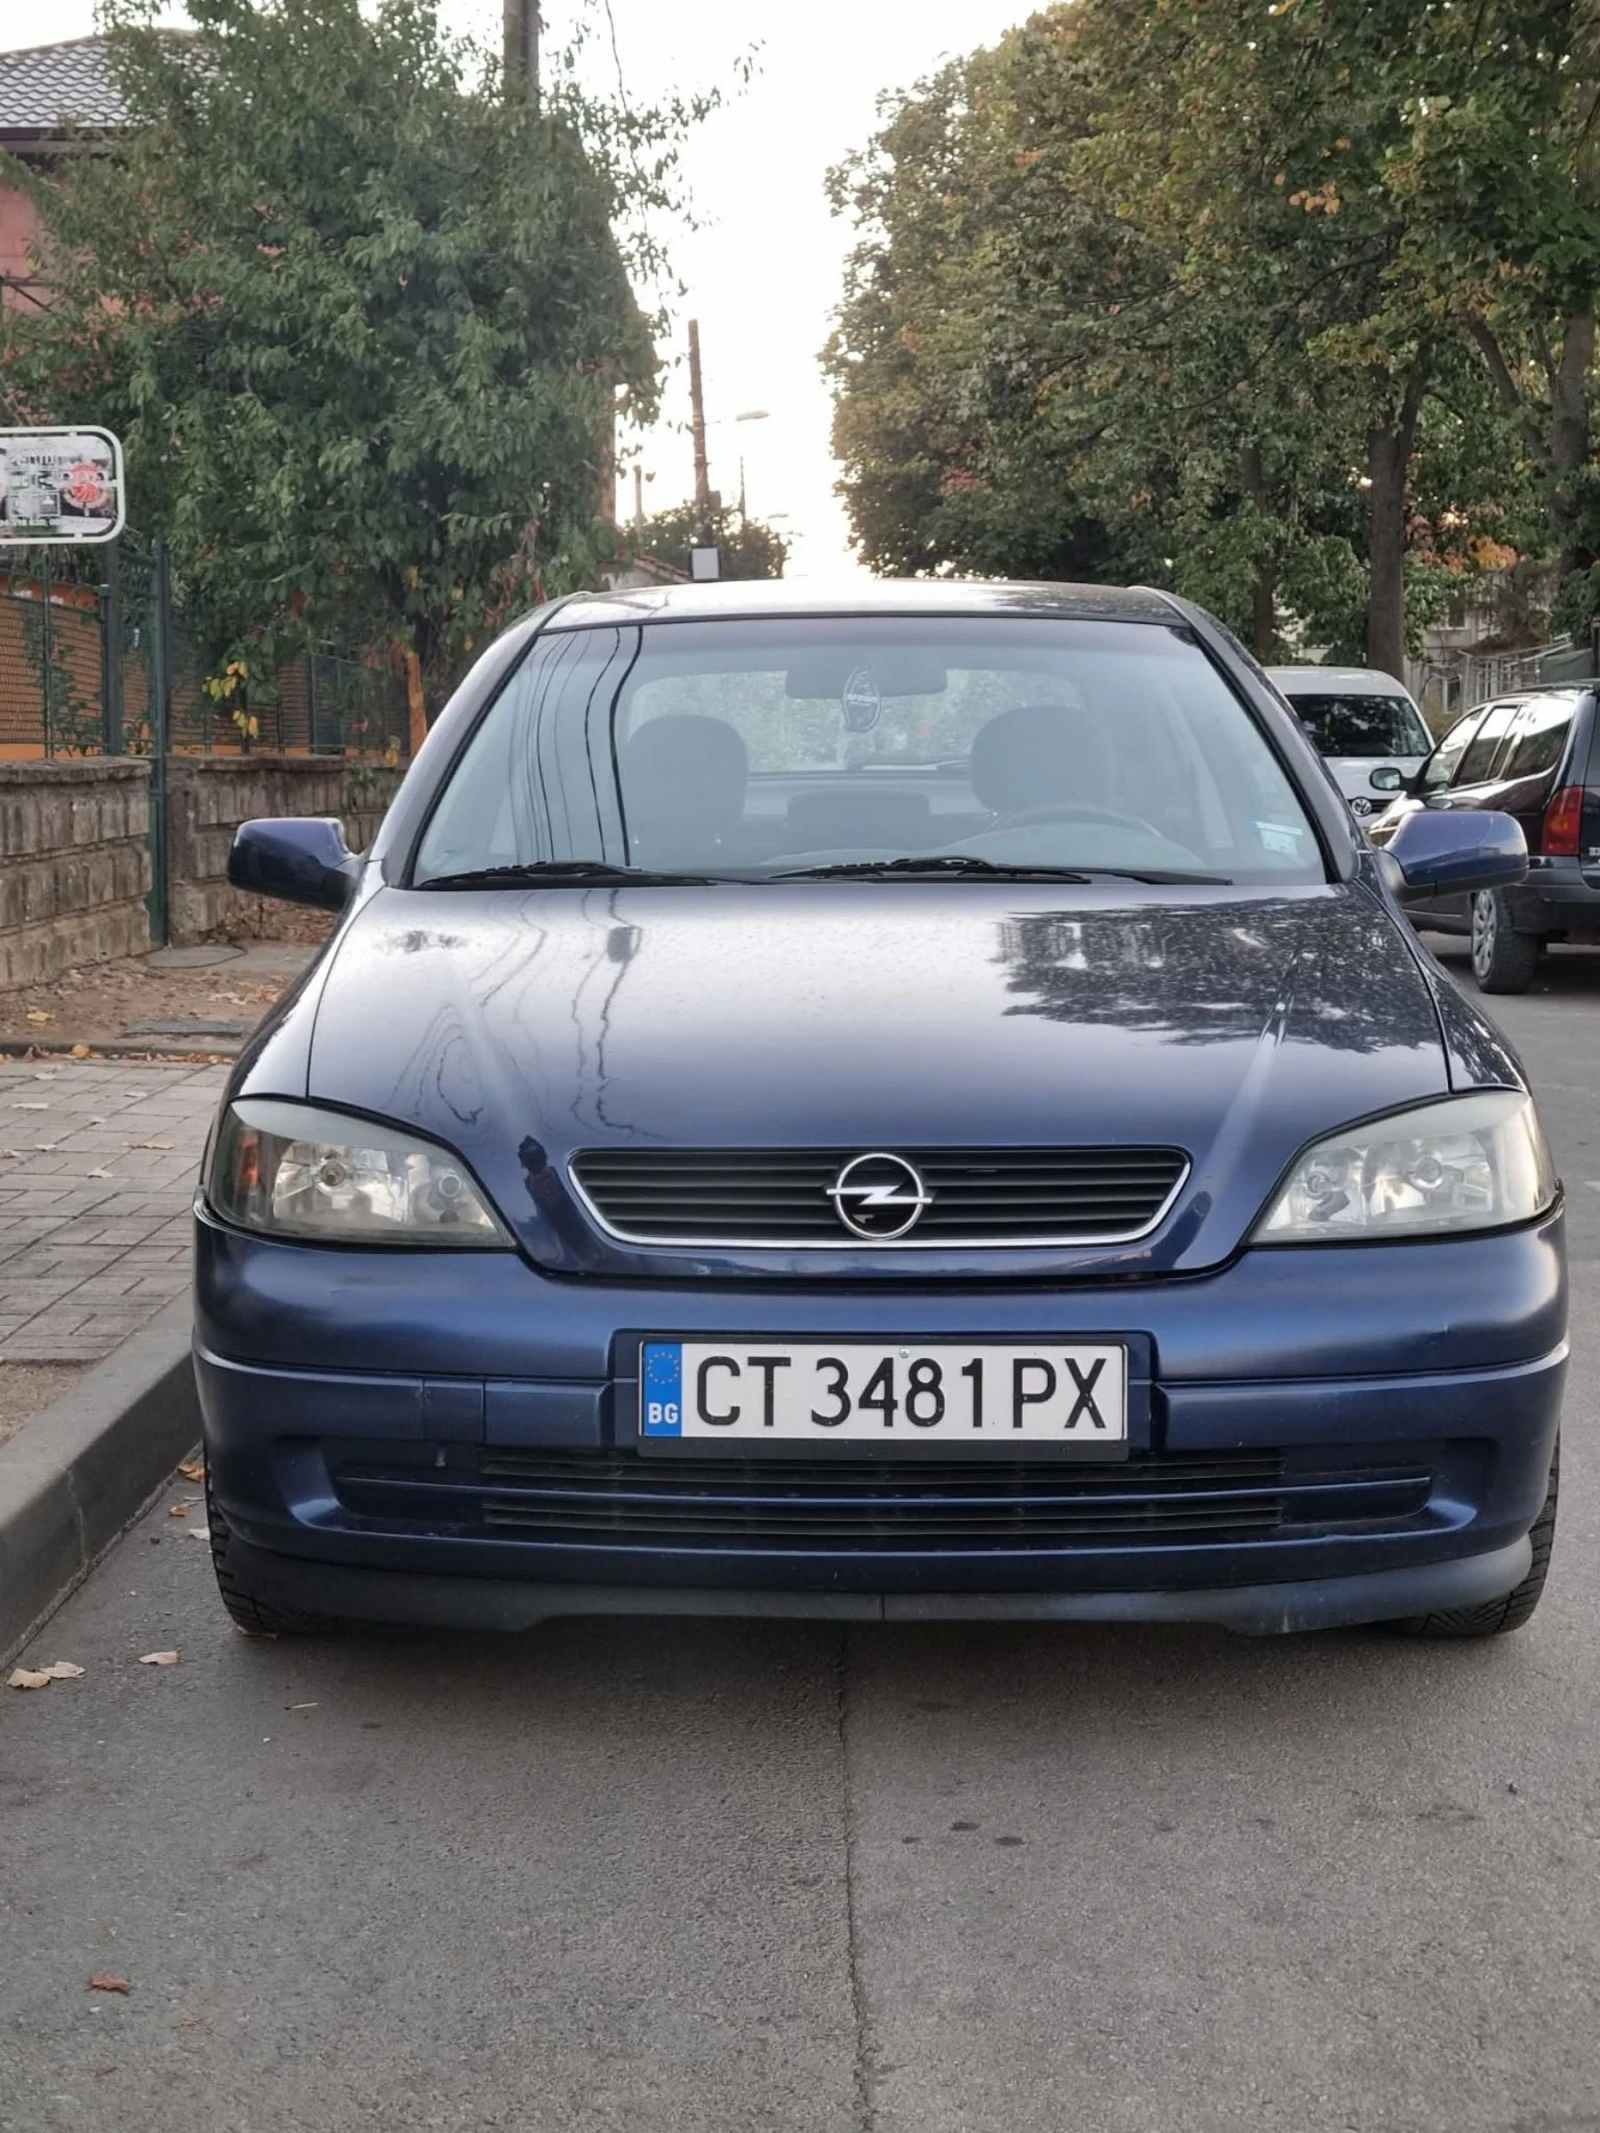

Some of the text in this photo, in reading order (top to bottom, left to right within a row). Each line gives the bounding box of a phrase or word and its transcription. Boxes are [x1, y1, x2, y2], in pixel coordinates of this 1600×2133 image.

[648, 1402, 679, 1424] BG
[696, 1355, 1107, 1430] CT 3481 PX
